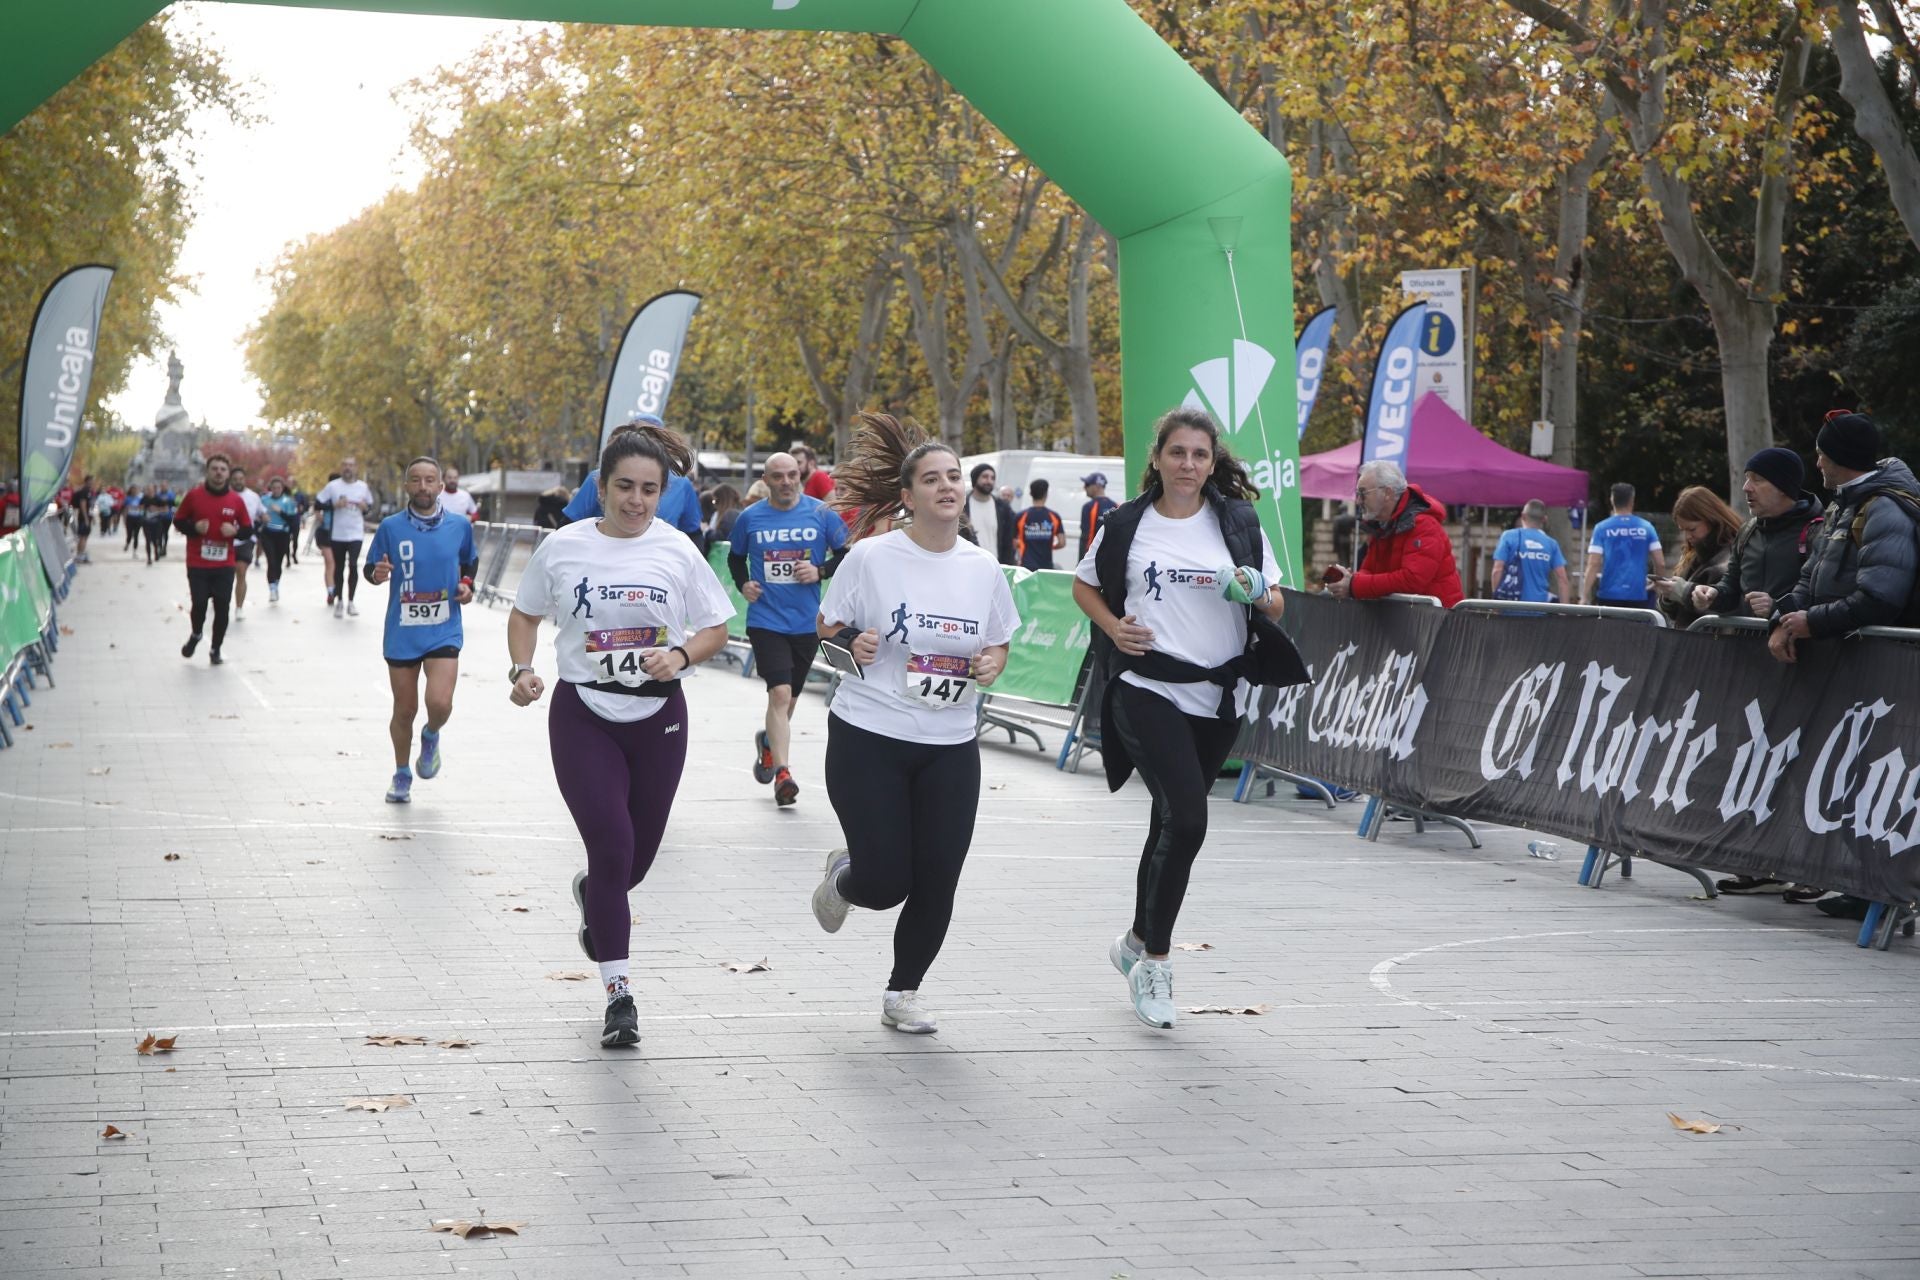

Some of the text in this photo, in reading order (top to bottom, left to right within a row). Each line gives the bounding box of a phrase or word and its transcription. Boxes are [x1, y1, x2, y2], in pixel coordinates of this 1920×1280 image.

[45, 326, 94, 448] Unicaja
[1373, 347, 1413, 463] VECO
[756, 528, 817, 544] IVECO
[1606, 528, 1647, 537] IVECO
[771, 563, 797, 577] 59
[409, 604, 441, 618] 597
[601, 631, 611, 643] 9ª
[612, 634, 642, 643] EMPRESAS
[920, 676, 967, 703] 147
[1479, 660, 1565, 781] El
[1556, 660, 1717, 815] Norte
[1717, 698, 1800, 826] de
